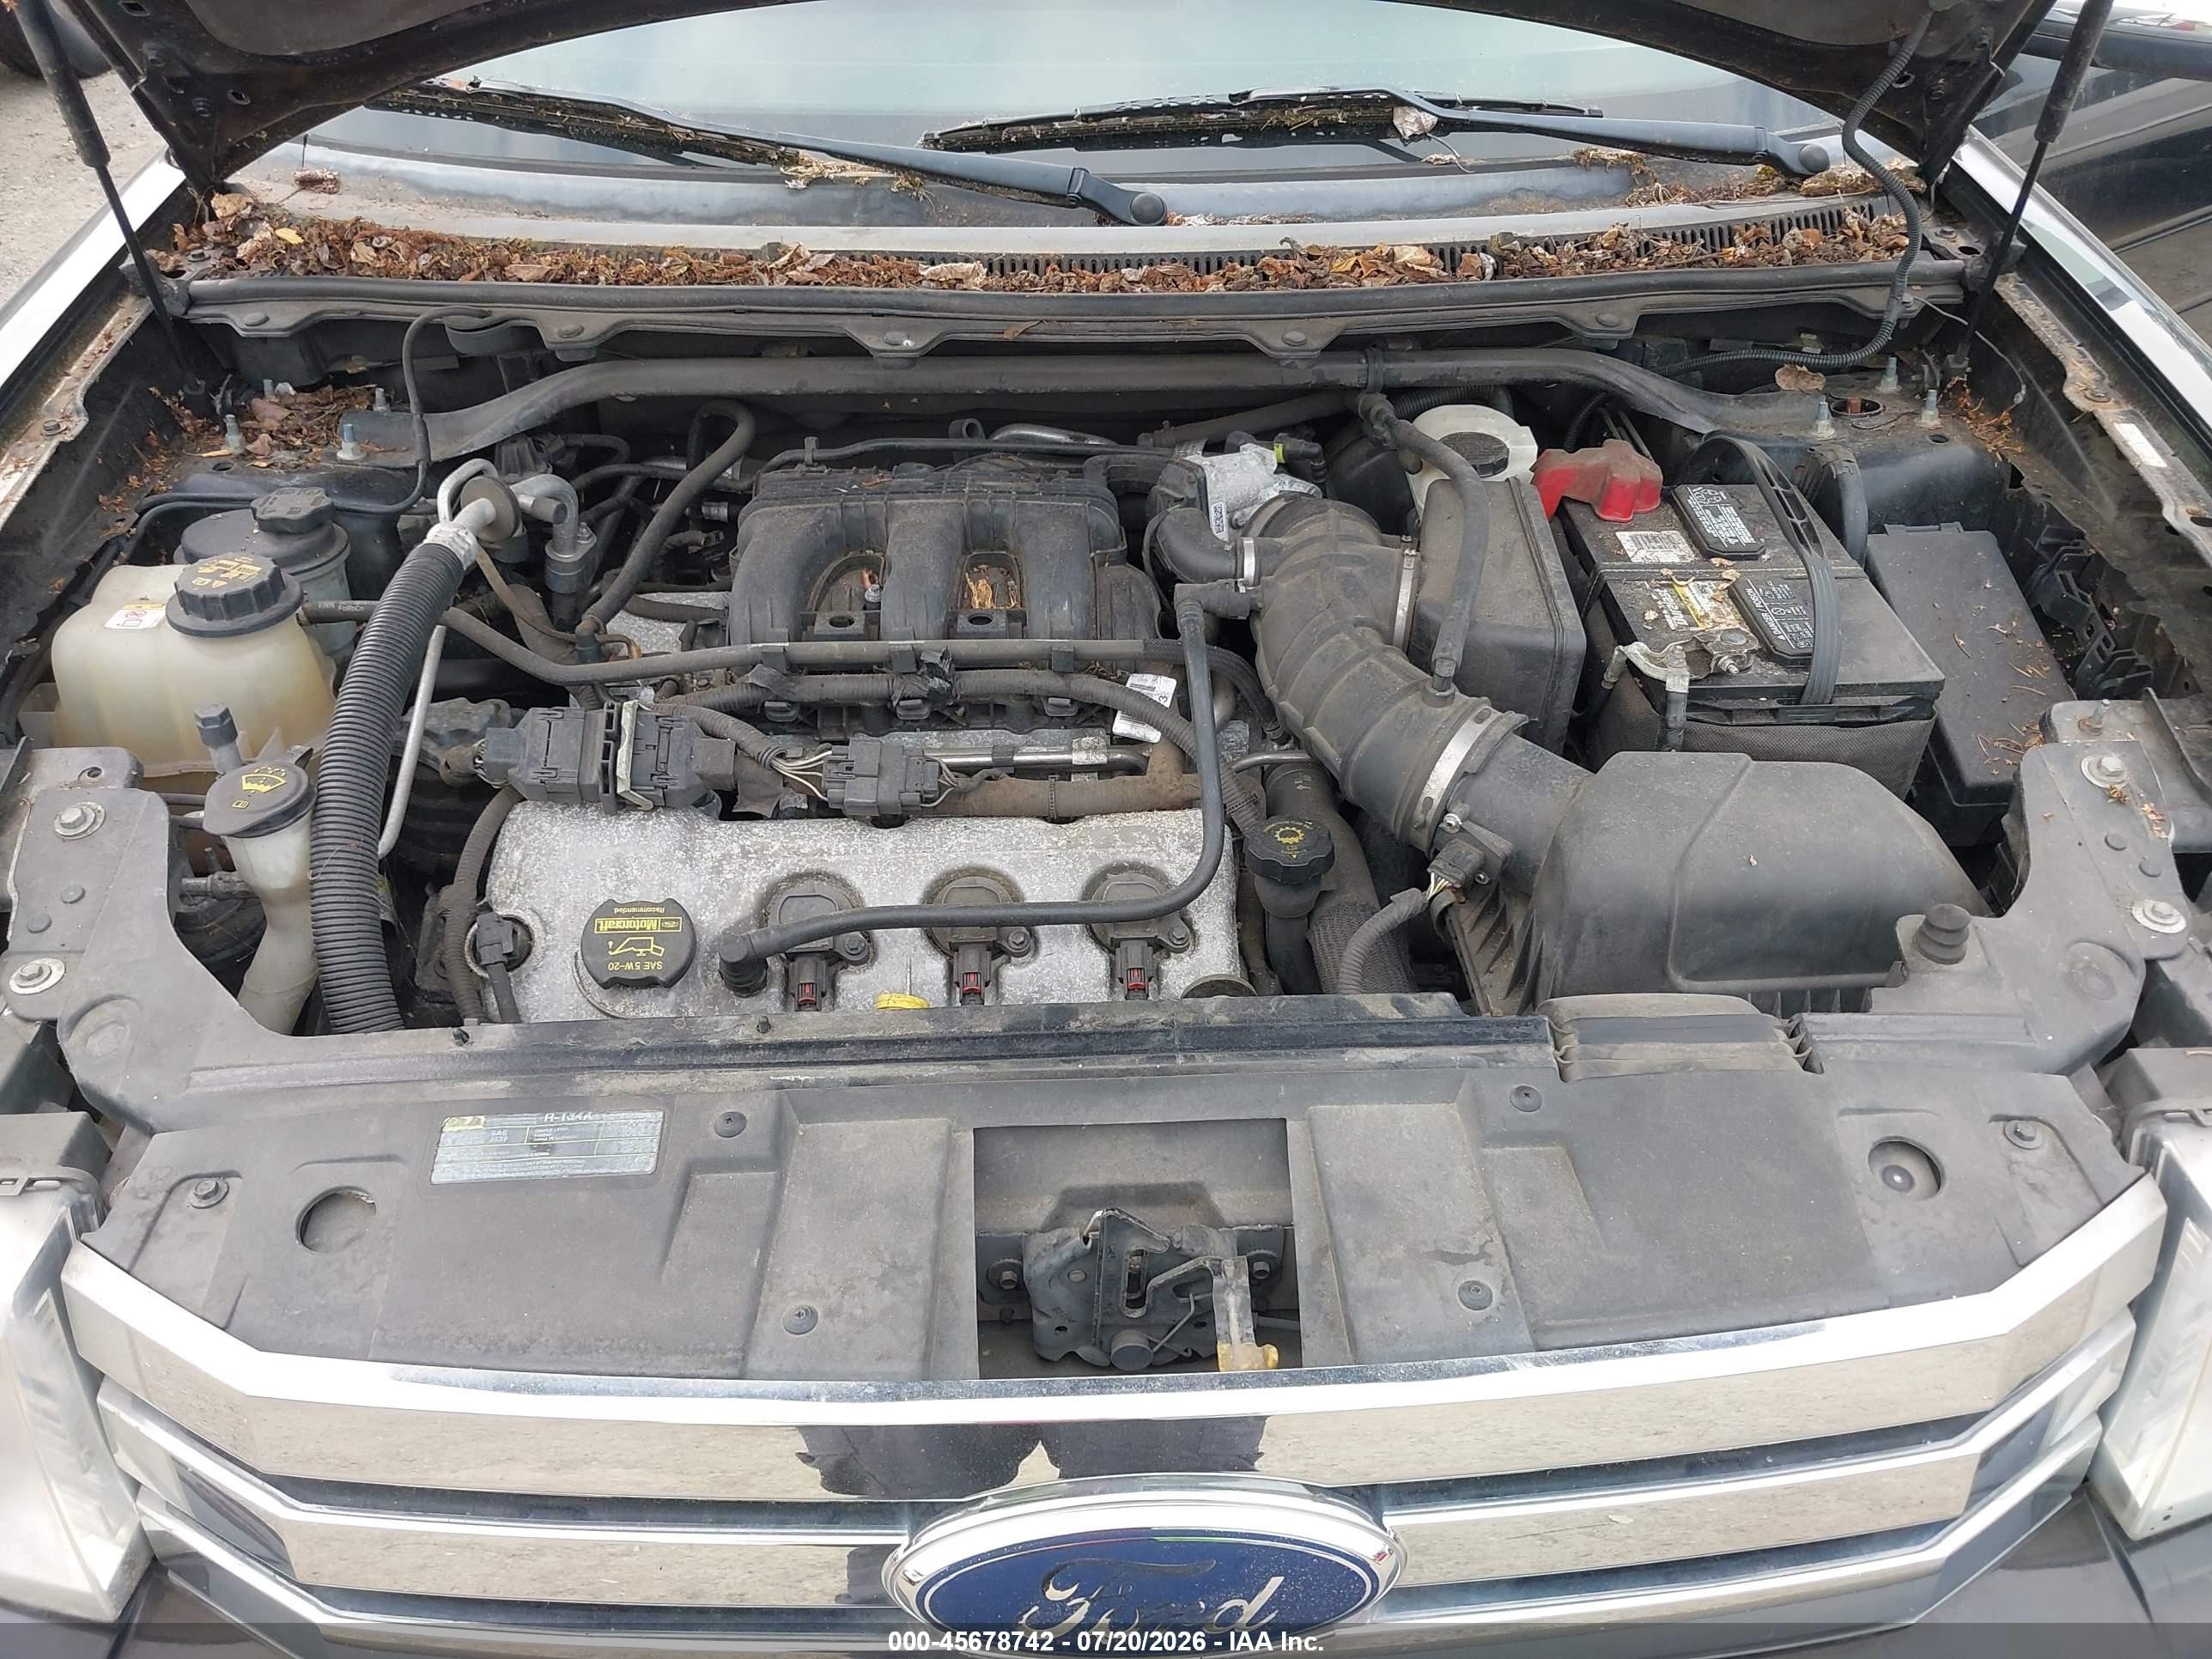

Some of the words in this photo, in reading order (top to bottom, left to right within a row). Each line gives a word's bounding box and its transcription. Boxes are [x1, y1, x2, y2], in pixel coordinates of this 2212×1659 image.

[1654, 587, 1689, 626] Duralast
[1745, 588, 1764, 608] POISON
[1761, 612, 1783, 635] DANGER
[597, 919, 658, 932] Motorcraft
[607, 961, 641, 971] 5W-20
[643, 961, 663, 970] SAE
[1016, 1557, 1285, 1644] Ford
